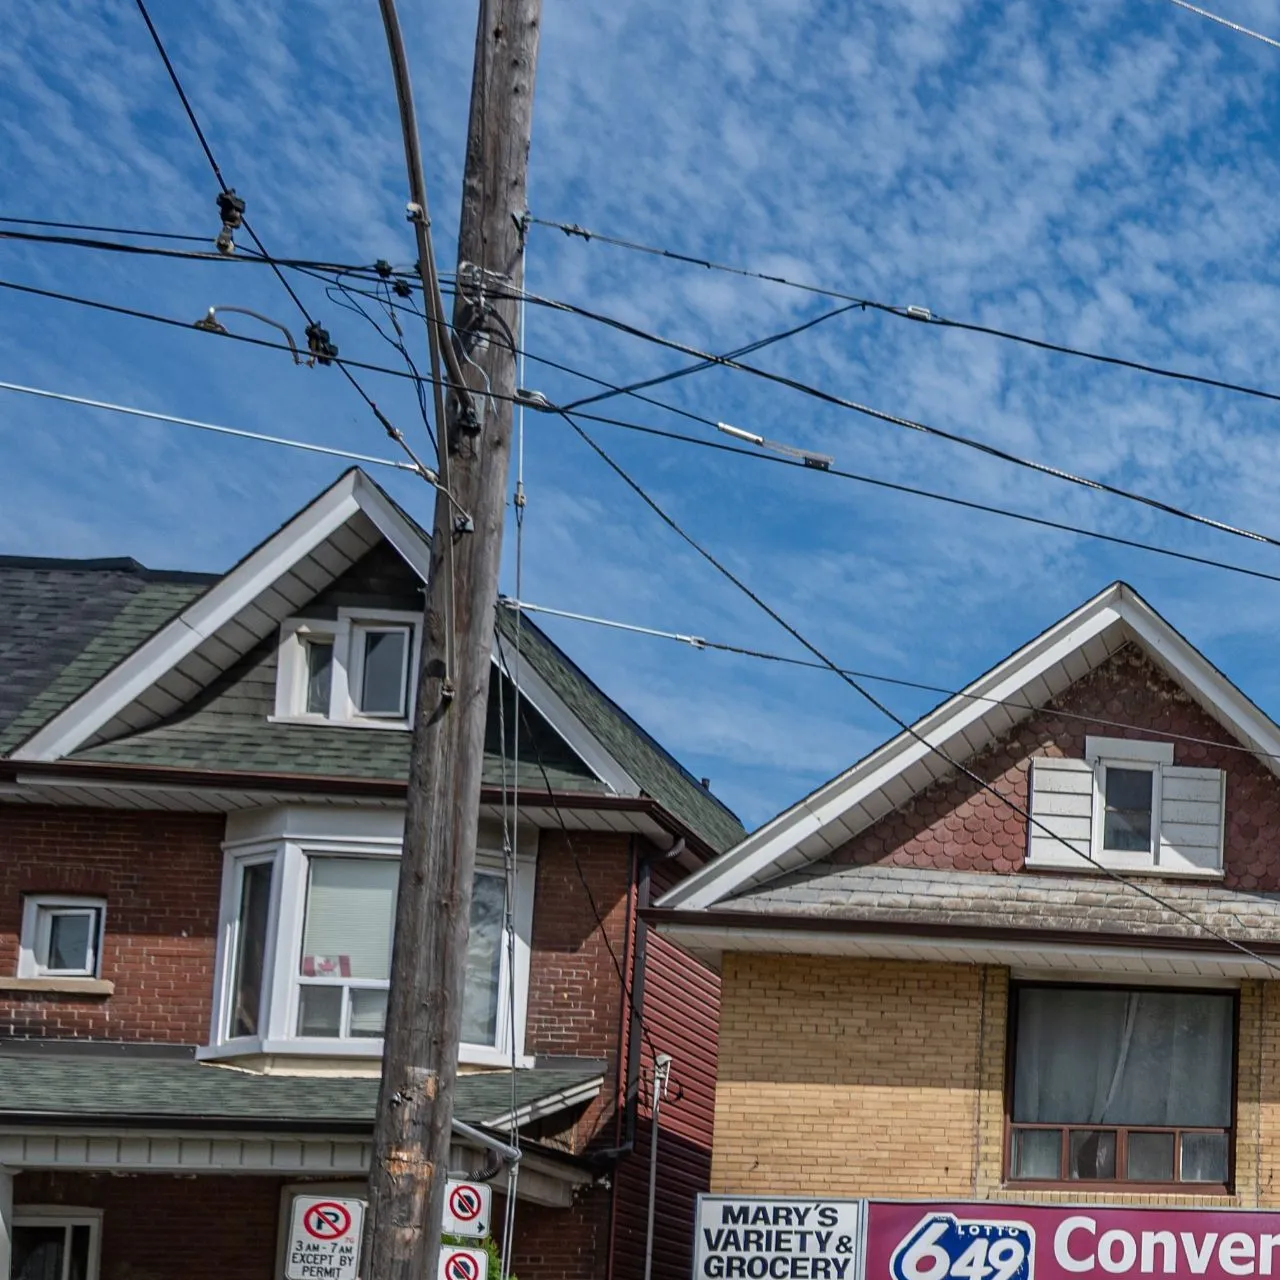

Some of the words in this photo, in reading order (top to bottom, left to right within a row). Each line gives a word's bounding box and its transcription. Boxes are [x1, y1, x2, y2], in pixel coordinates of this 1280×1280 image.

[721, 1204, 839, 1227] MARY'S
[957, 1224, 1020, 1237] LOTTO
[704, 1228, 833, 1253] VARIETY
[835, 1235, 854, 1254] &
[292, 1253, 334, 1265] EXCEPT
[340, 1256, 355, 1267] BY
[704, 1255, 851, 1280] GROCERY
[302, 1266, 342, 1278] PERMIT
